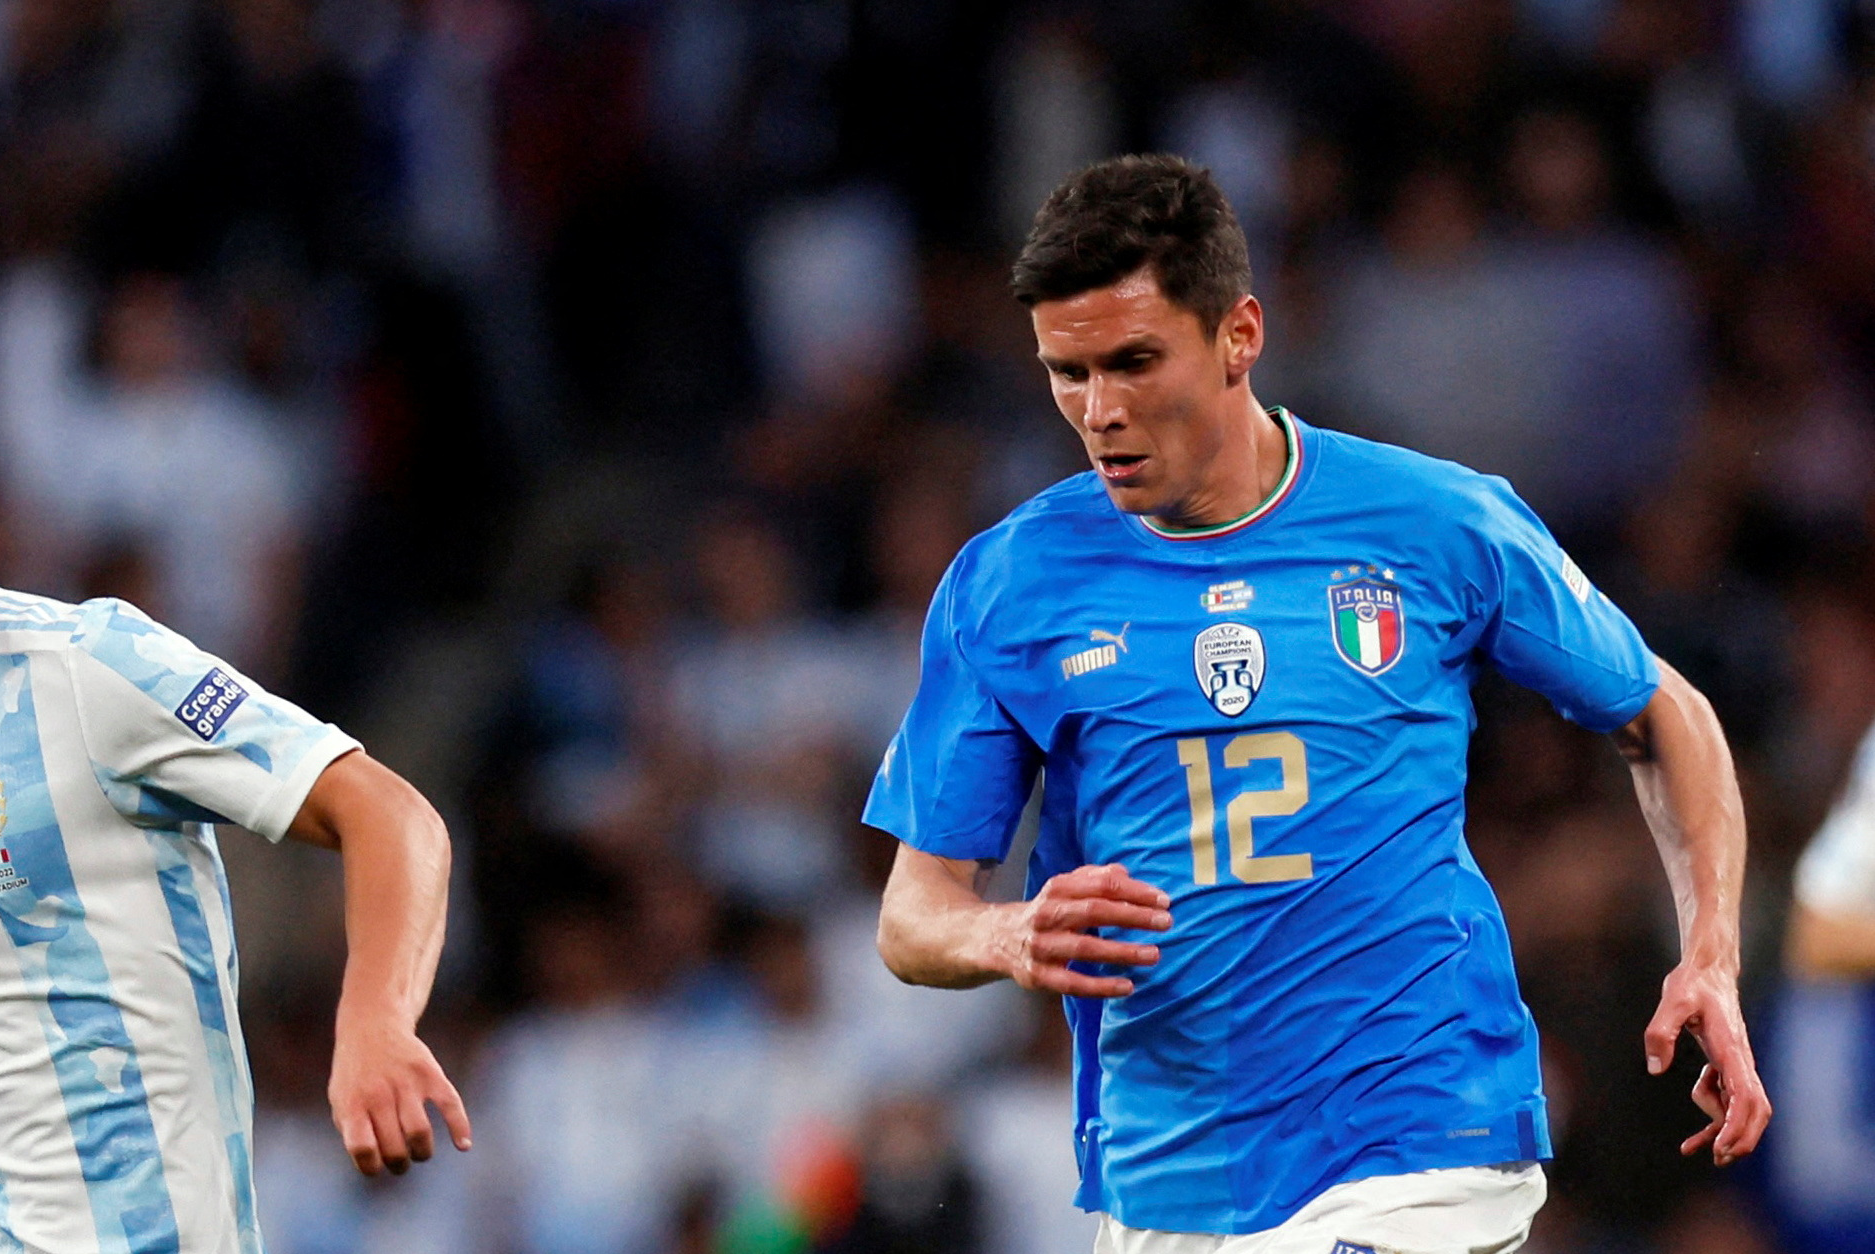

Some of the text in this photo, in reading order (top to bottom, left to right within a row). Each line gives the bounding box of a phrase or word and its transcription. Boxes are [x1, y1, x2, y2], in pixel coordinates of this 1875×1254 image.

[1335, 588, 1398, 604] ITALIA
[1211, 627, 1240, 639] UEFA
[1204, 640, 1252, 650] EUROPEAN
[1205, 647, 1252, 658] CHAMPIONS
[1061, 645, 1117, 681] PUMA
[181, 673, 230, 721] Cree en
[1222, 696, 1244, 706] 2020
[196, 684, 242, 736] grande
[1177, 731, 1314, 885] 12
